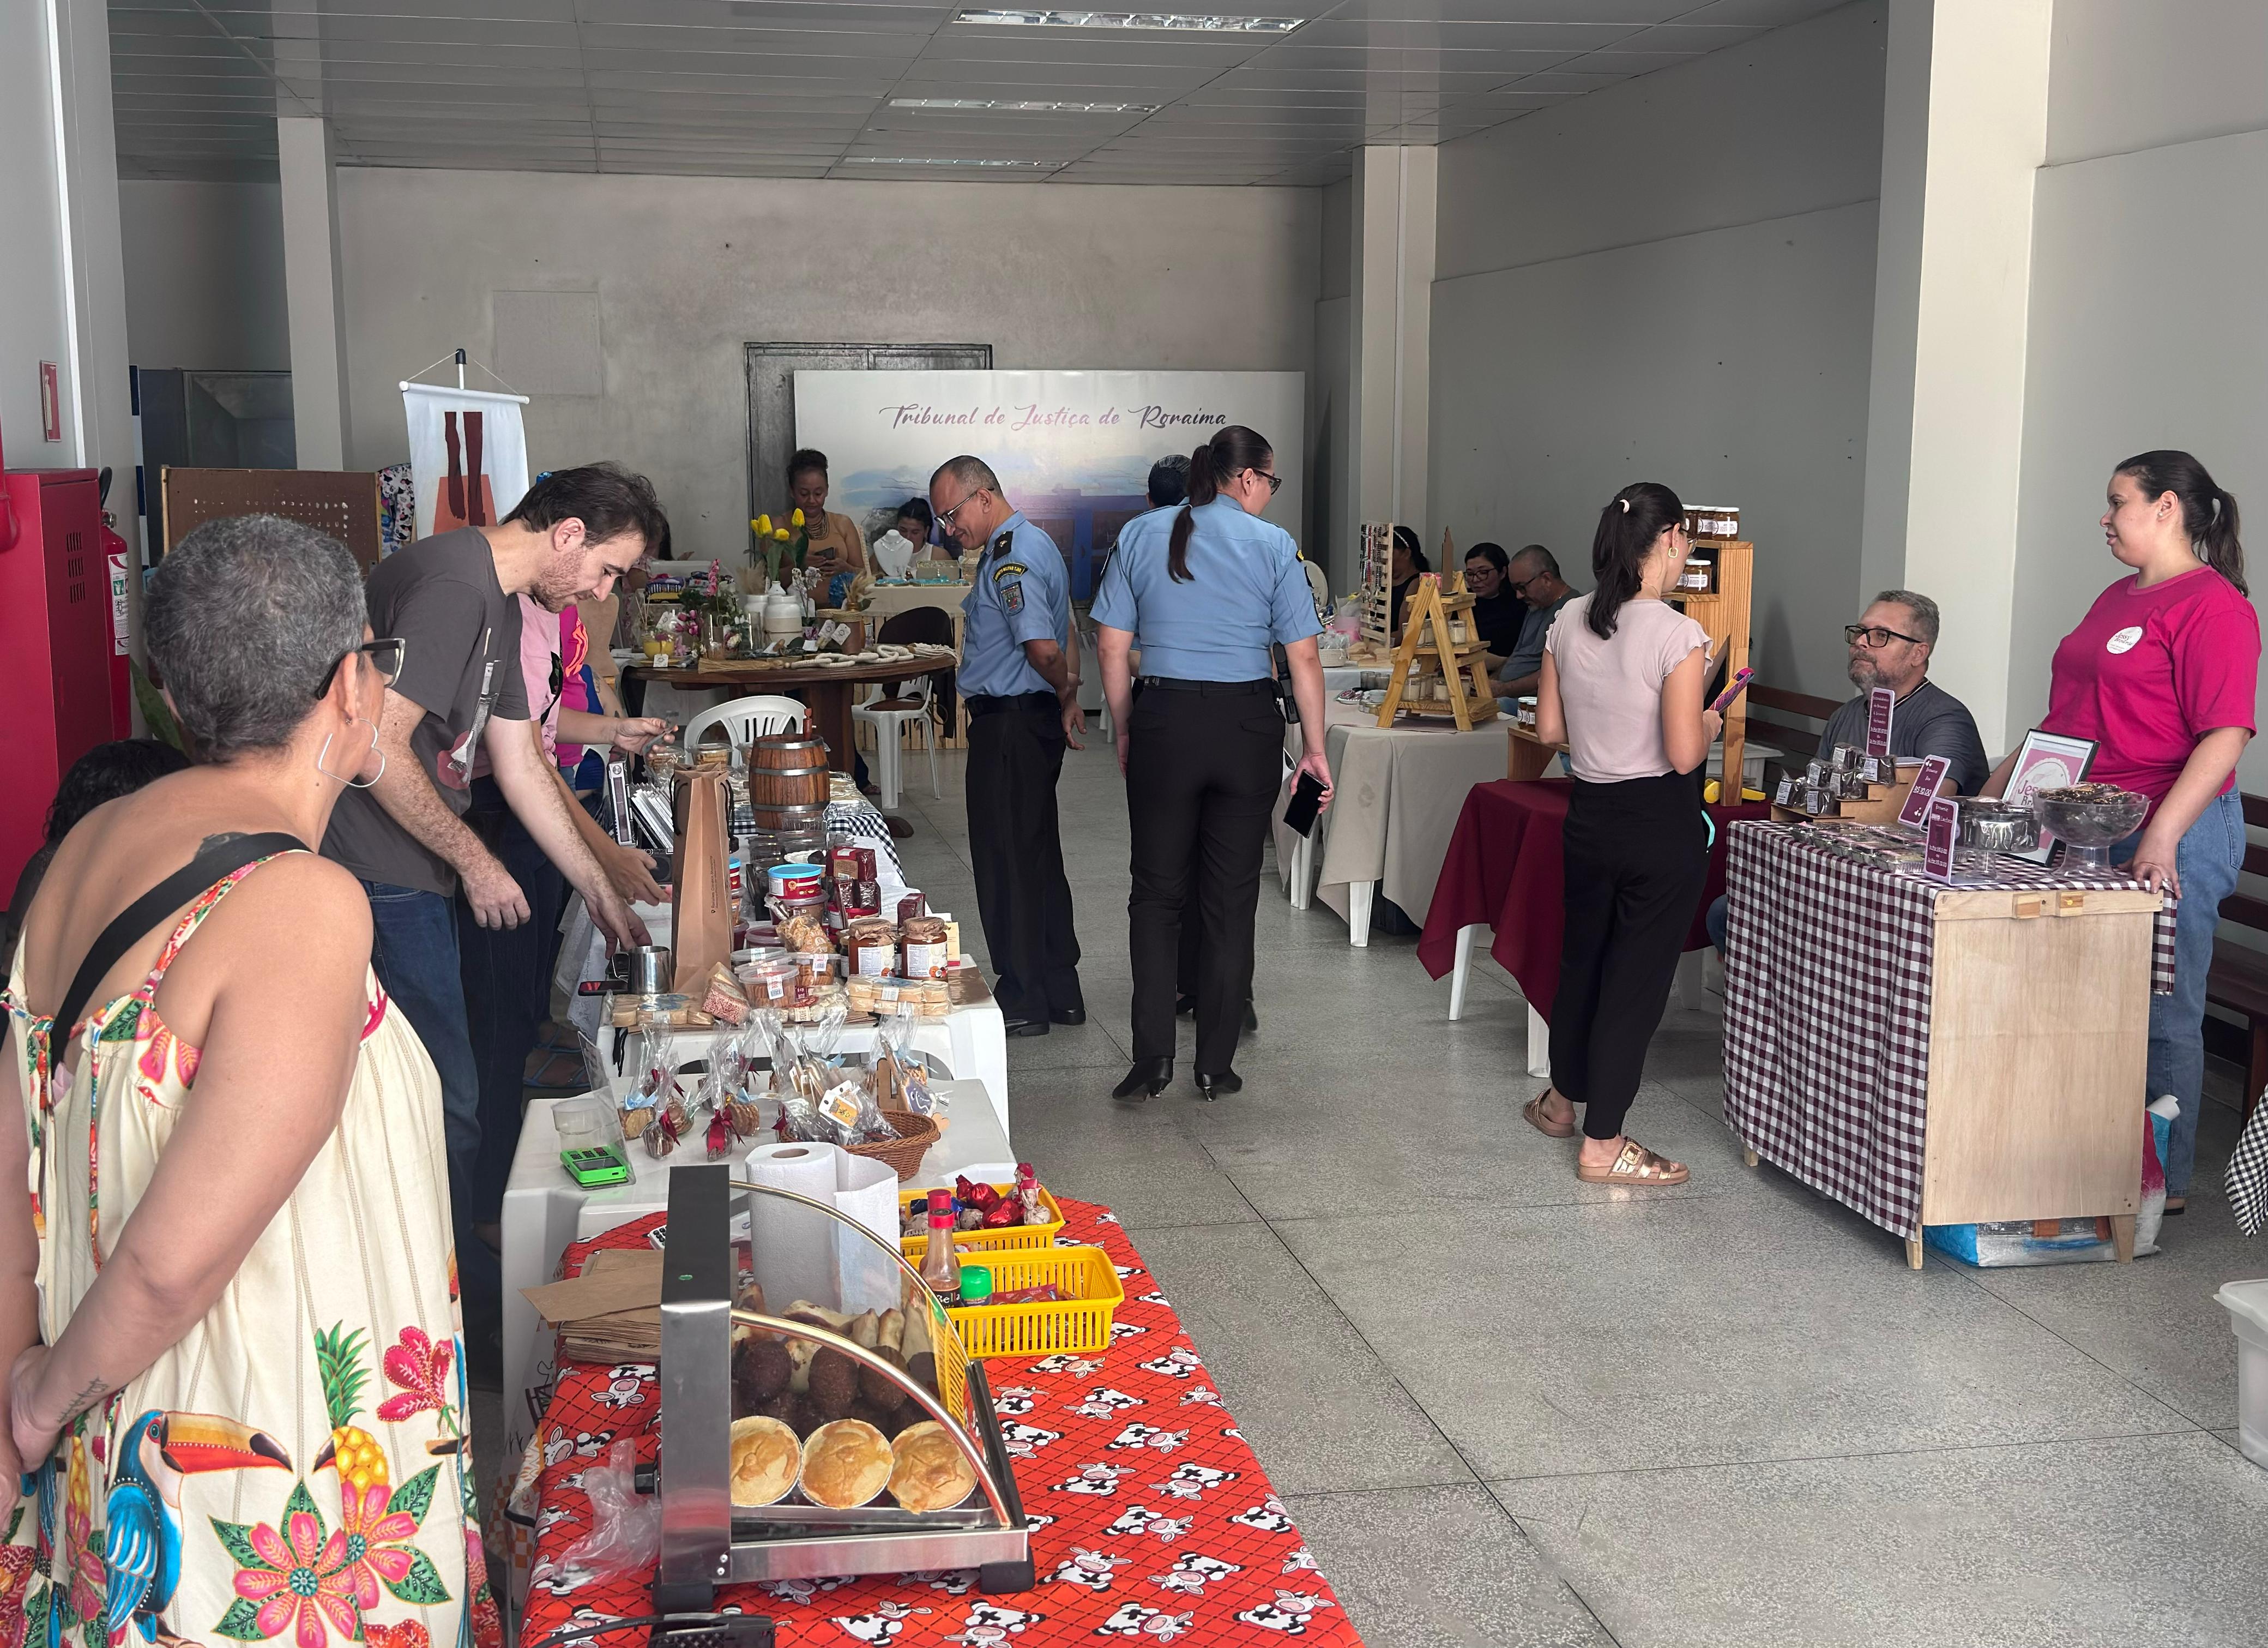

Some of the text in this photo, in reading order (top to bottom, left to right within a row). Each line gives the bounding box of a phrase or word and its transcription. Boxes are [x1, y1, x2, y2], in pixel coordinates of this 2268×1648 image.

[879, 404, 1227, 431] Tribunal de Justiça de Roraima
